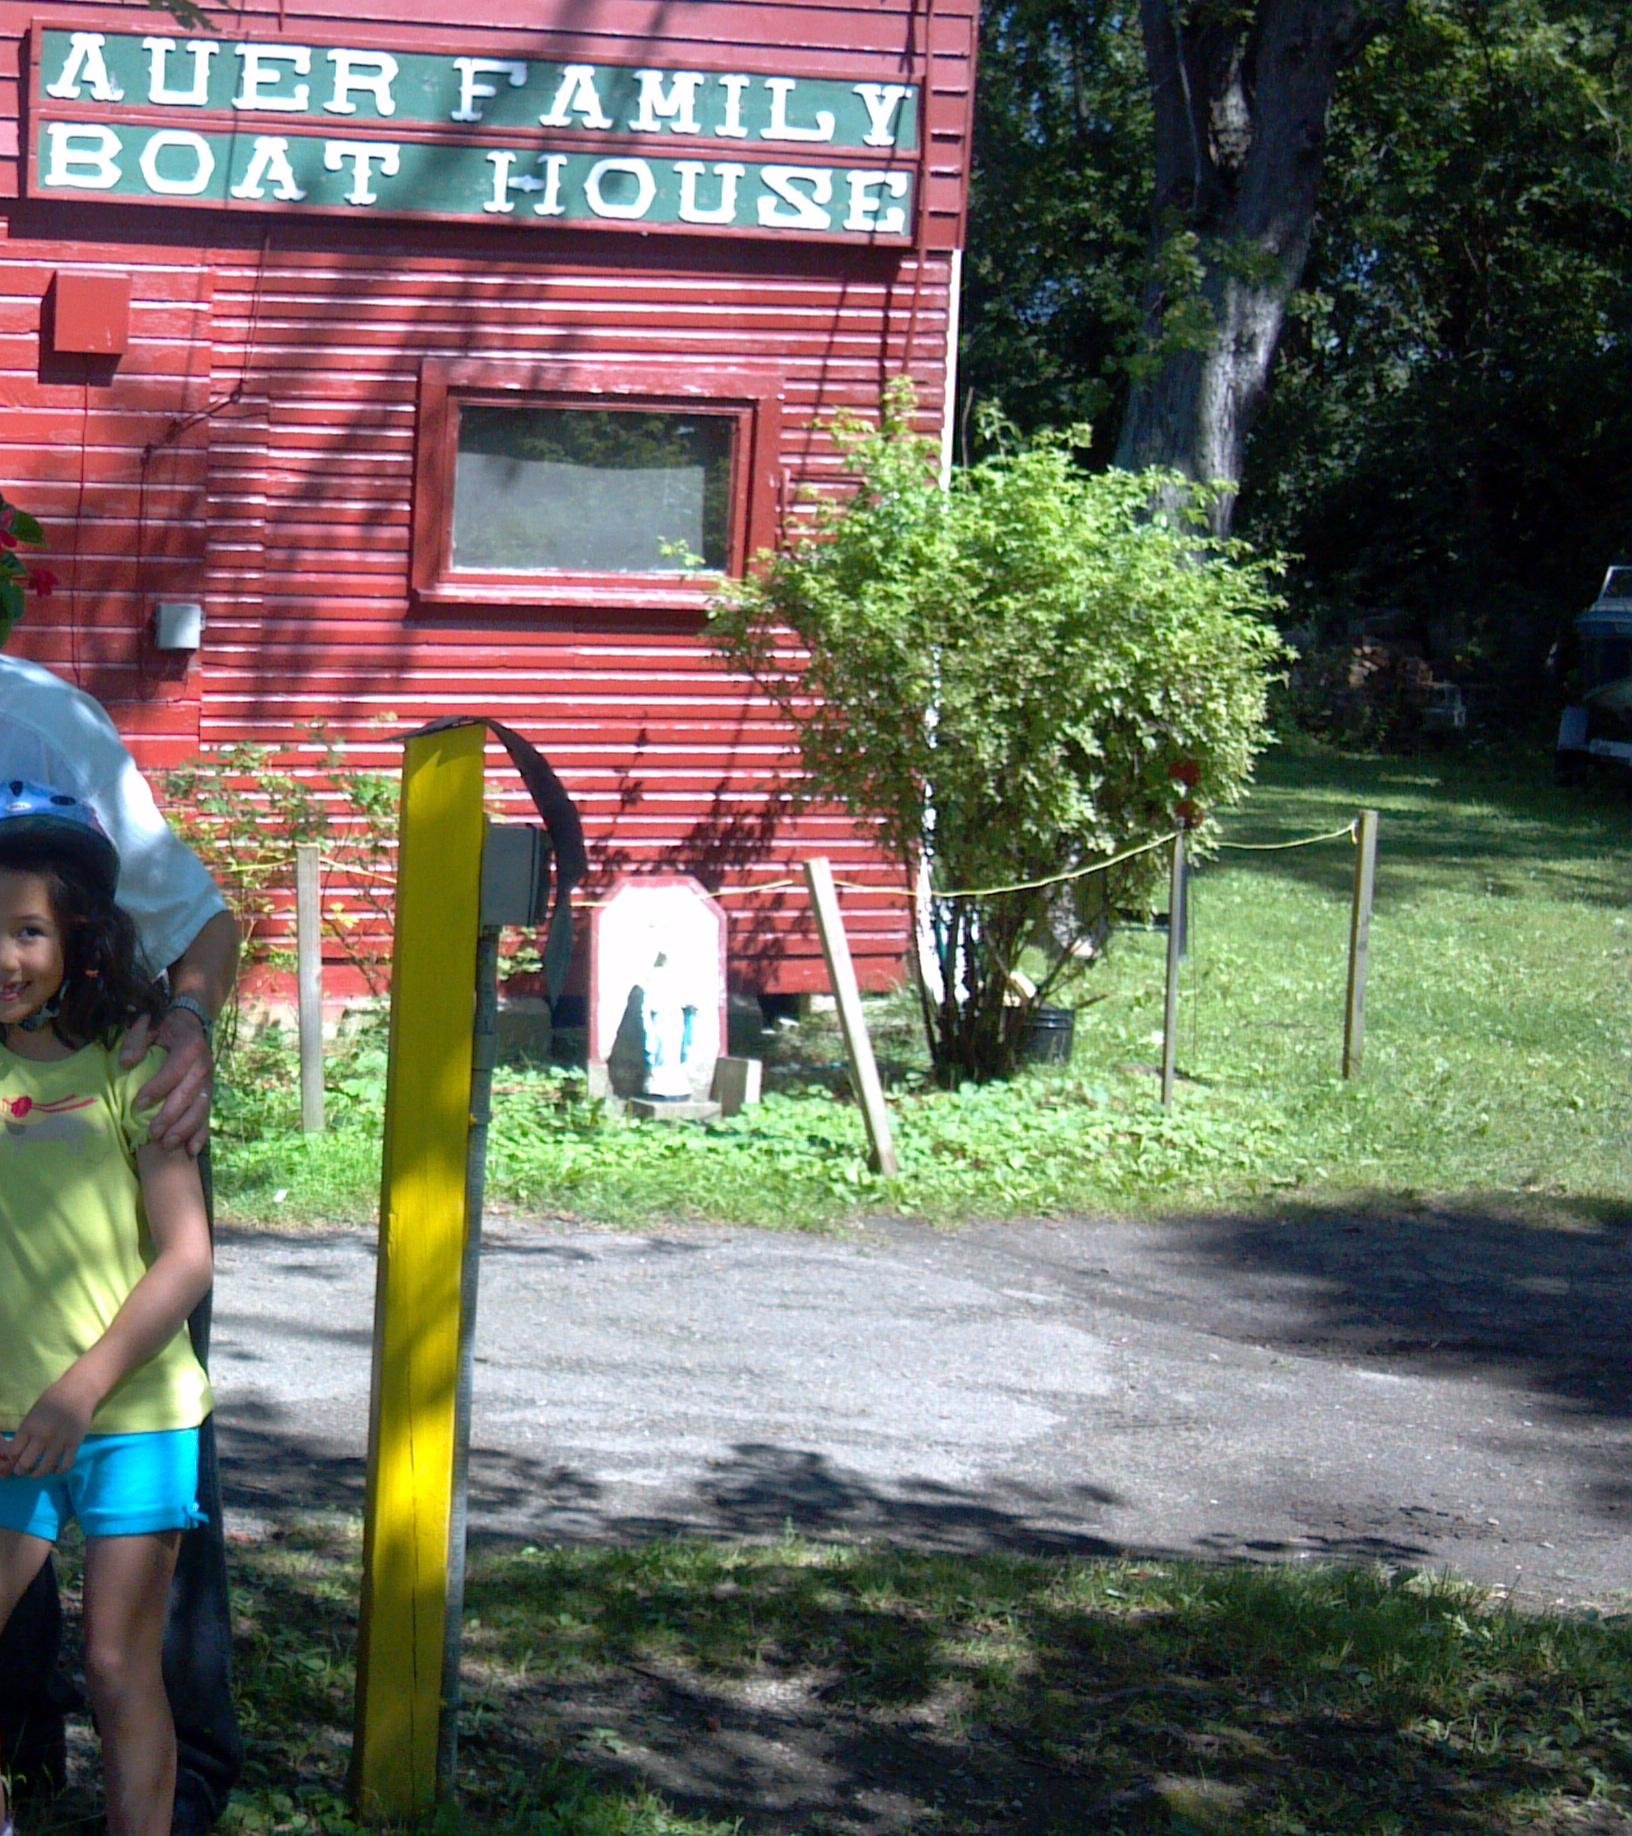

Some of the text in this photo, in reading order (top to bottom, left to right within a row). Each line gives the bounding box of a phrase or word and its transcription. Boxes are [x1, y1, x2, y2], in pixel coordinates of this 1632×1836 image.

[46, 32, 911, 147] AUER FAMILY
[45, 121, 909, 234] BOAT HOUSE
